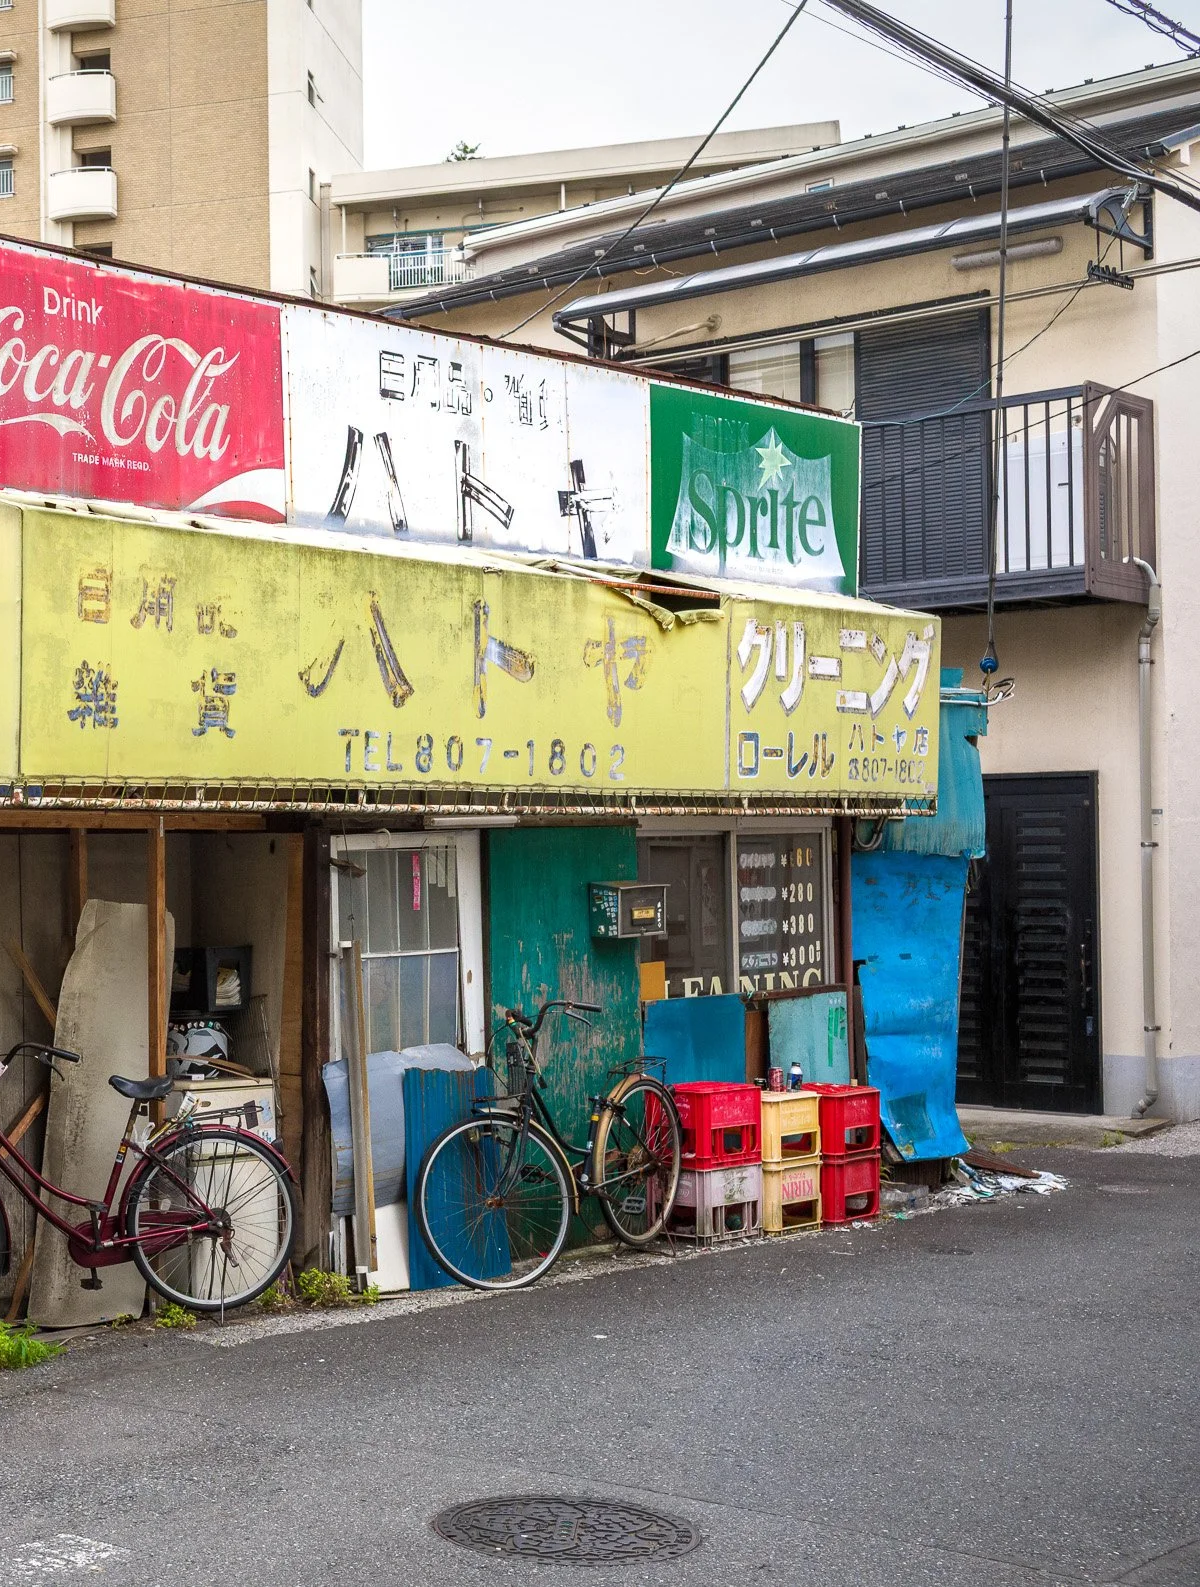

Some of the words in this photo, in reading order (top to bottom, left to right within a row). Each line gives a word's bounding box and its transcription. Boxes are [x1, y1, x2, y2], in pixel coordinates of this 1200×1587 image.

[43, 287, 104, 326] Drink
[72, 452, 100, 465] TRADE
[102, 456, 126, 469] MARK
[688, 468, 827, 571] Sprite
[737, 619, 937, 720] クリーニング
[848, 723, 930, 756] ハトヤ店
[737, 731, 835, 779] ローレル
[782, 883, 813, 903] ¥280
[783, 913, 814, 935] ¥380
[783, 944, 814, 966] ¥300
[782, 1178, 814, 1200] KIRIN
